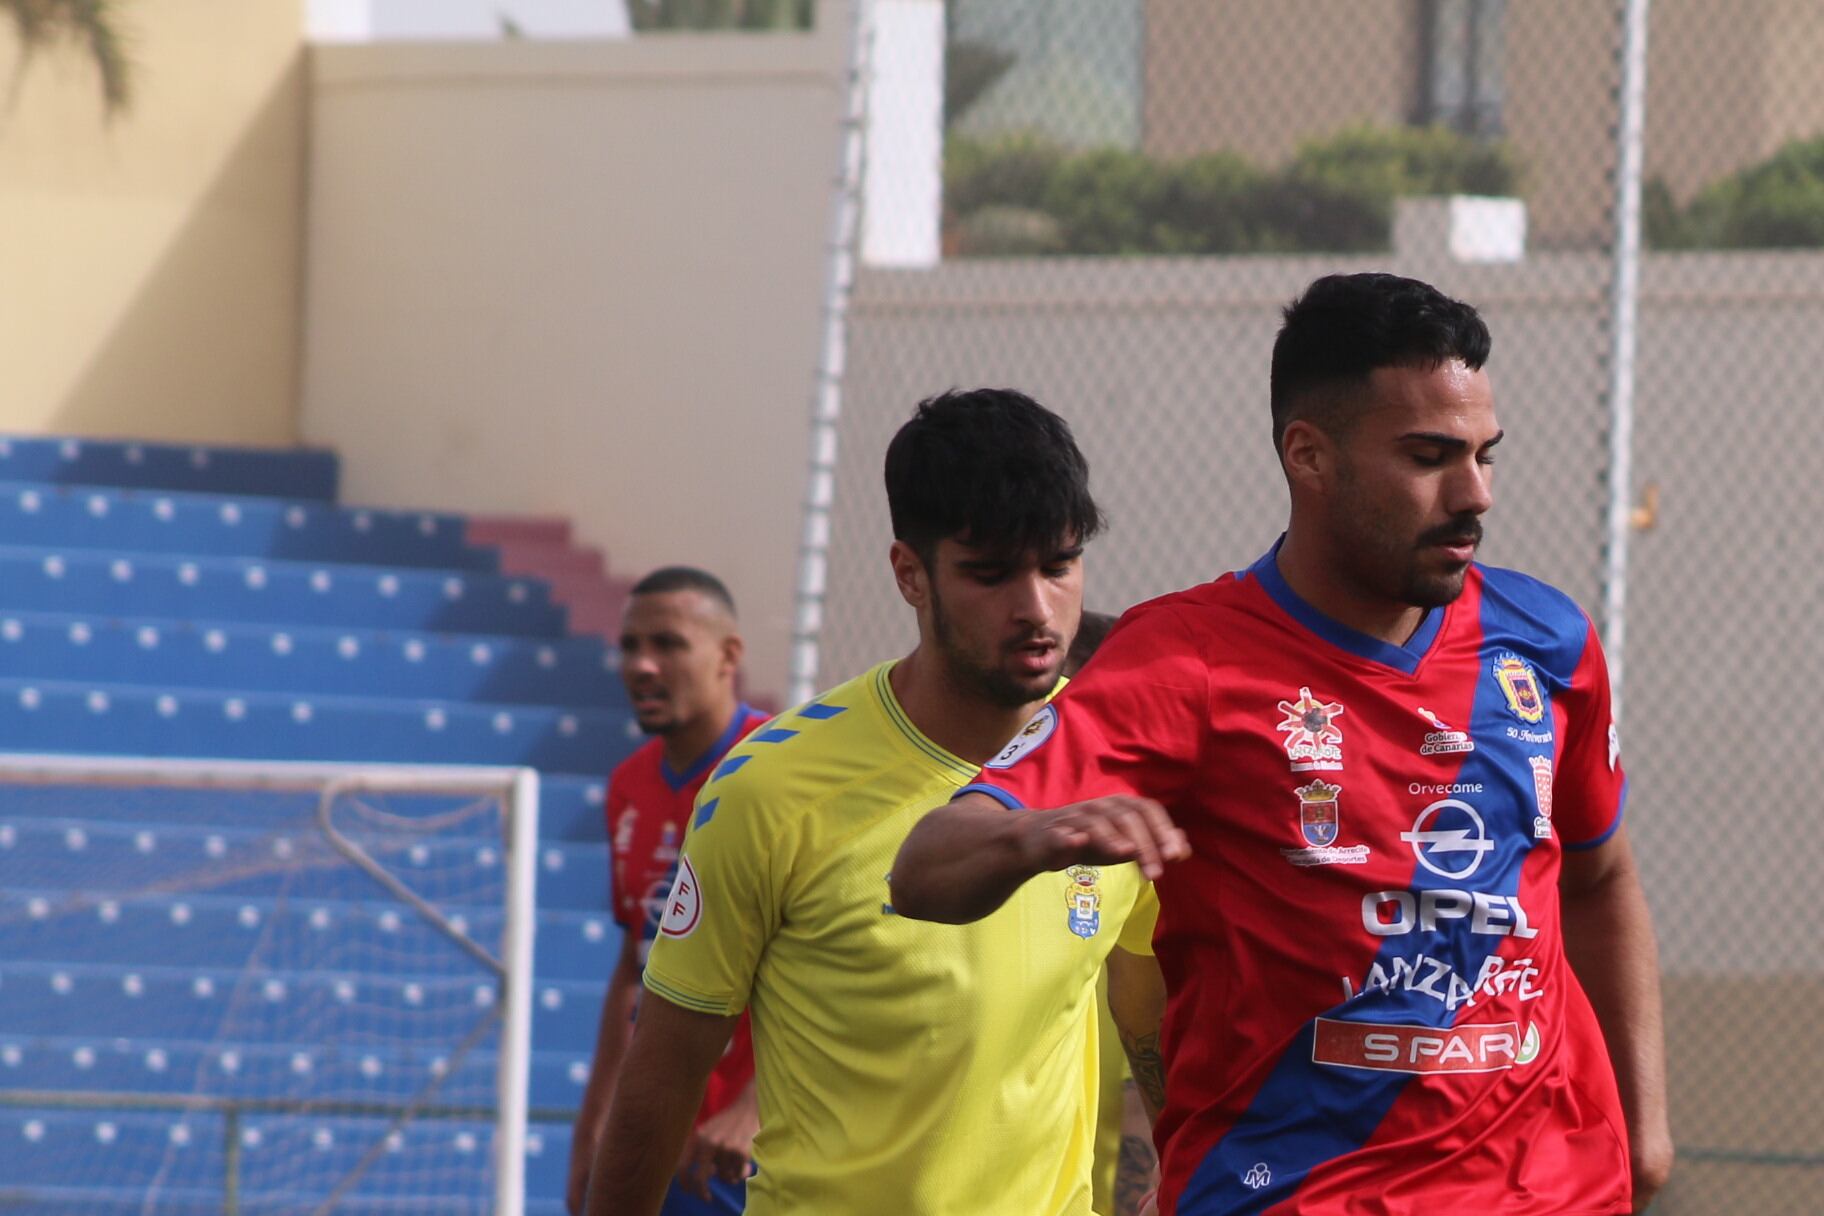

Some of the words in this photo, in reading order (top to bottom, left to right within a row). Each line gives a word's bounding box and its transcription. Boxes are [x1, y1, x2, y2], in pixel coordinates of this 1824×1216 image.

[1506, 726, 1519, 739] 50
[1421, 745, 1433, 754] de
[1434, 742, 1473, 752] Canarias
[1408, 782, 1483, 795] Orvecame
[1361, 889, 1540, 939] OPEL
[1364, 1033, 1516, 1064] SPAR
